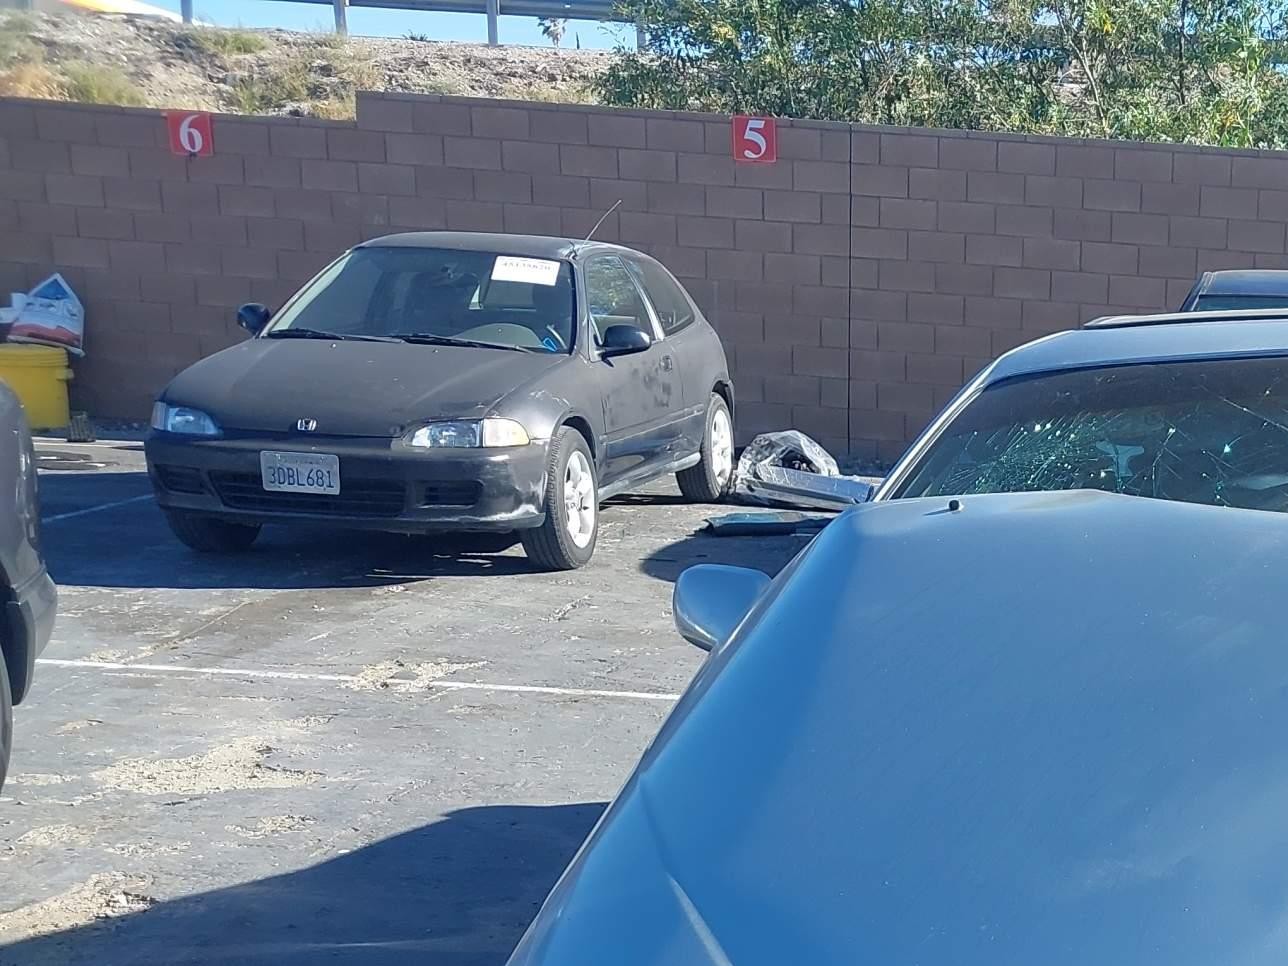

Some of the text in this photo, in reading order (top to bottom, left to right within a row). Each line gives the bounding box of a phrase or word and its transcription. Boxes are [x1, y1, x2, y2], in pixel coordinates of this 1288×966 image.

[179, 114, 203, 153] 6
[743, 119, 767, 159] 5
[267, 466, 335, 489] 3DBL681
